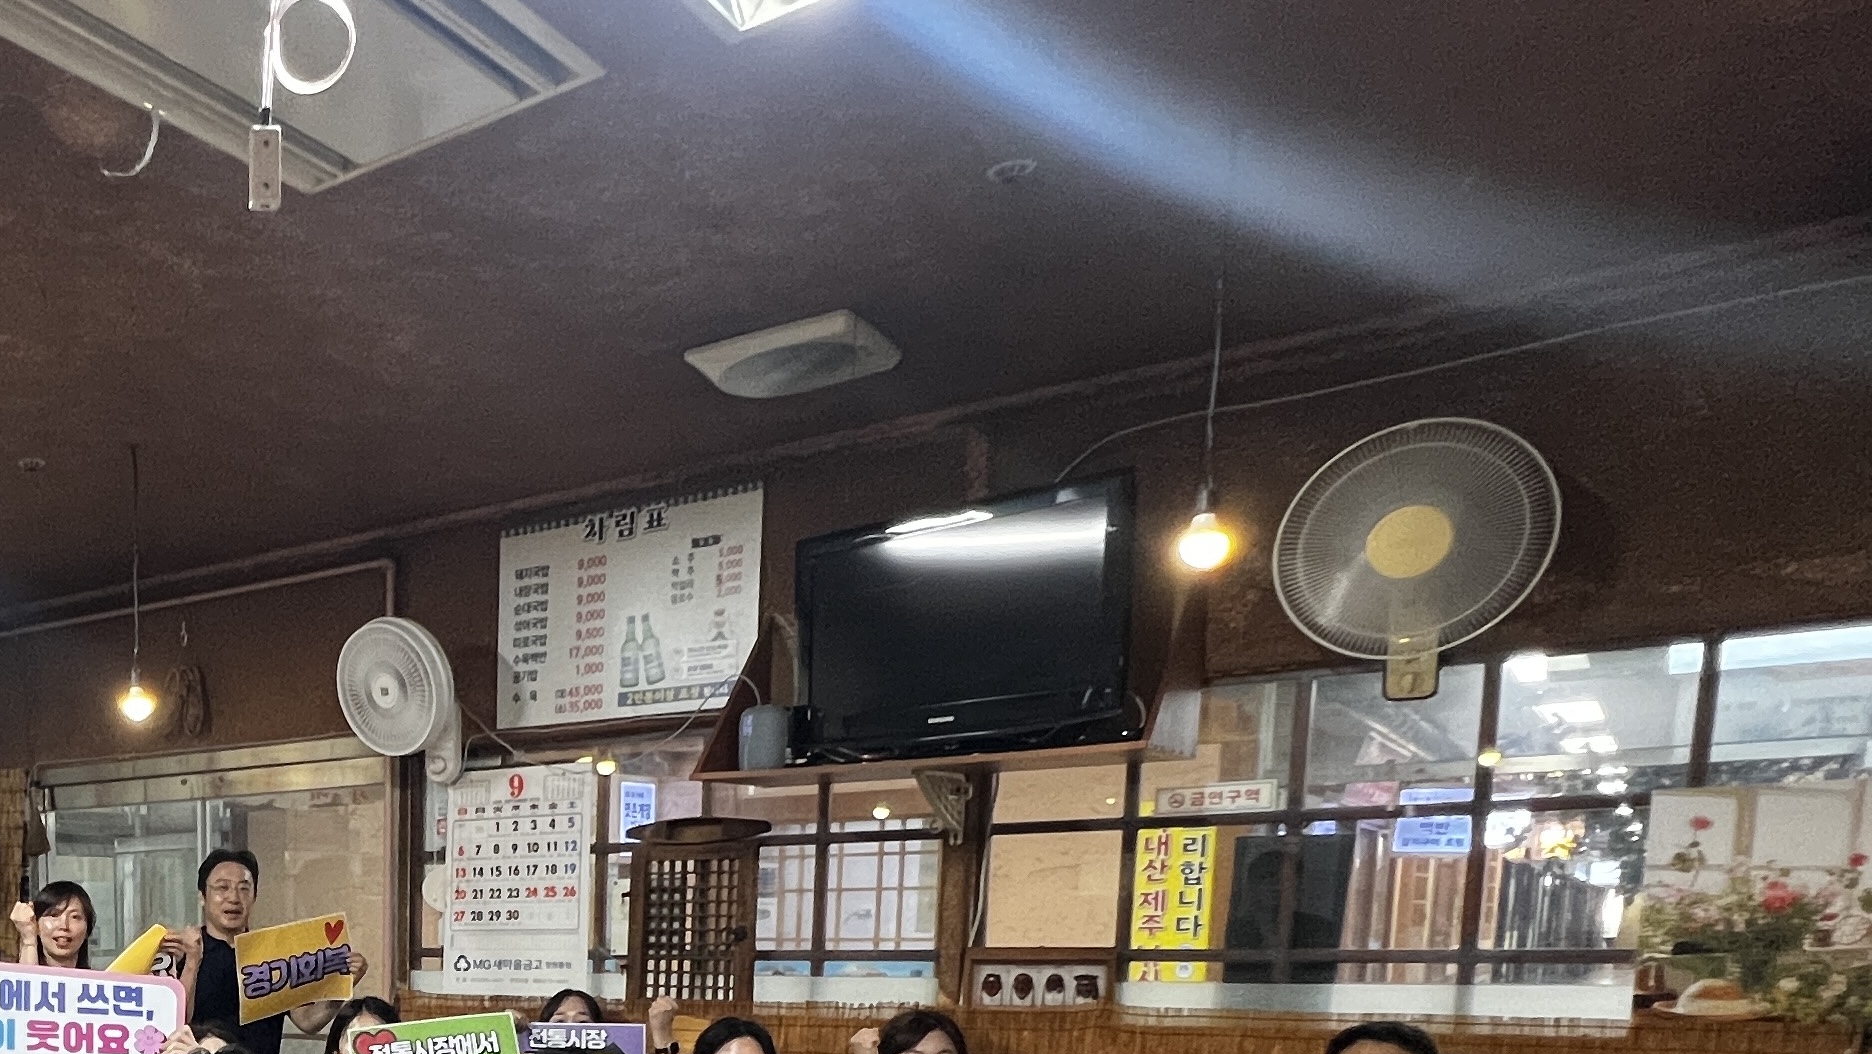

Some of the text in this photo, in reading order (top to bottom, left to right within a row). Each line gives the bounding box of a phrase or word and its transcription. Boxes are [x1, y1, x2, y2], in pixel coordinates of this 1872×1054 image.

[584, 507, 668, 541] 차림표
[508, 774, 524, 798] 9
[1190, 788, 1260, 807] 금연구역
[512, 821, 519, 832] 2
[530, 820, 537, 830] 3
[549, 819, 556, 829] 4
[568, 817, 575, 828] 5
[458, 840, 577, 857] 6 7 8 9 10 11 12
[456, 863, 576, 878] 13 14 15 16 17 18 19
[455, 886, 576, 900] 20 21 22 23 24 25 26
[1175, 834, 1207, 938] 리합니다
[454, 910, 519, 922] 27 28 29 30
[241, 944, 352, 999] 경기회복
[77, 987, 154, 1021] 쓰면,
[25, 1021, 130, 1054] 웃어요
[529, 1027, 607, 1049] 전통시장
